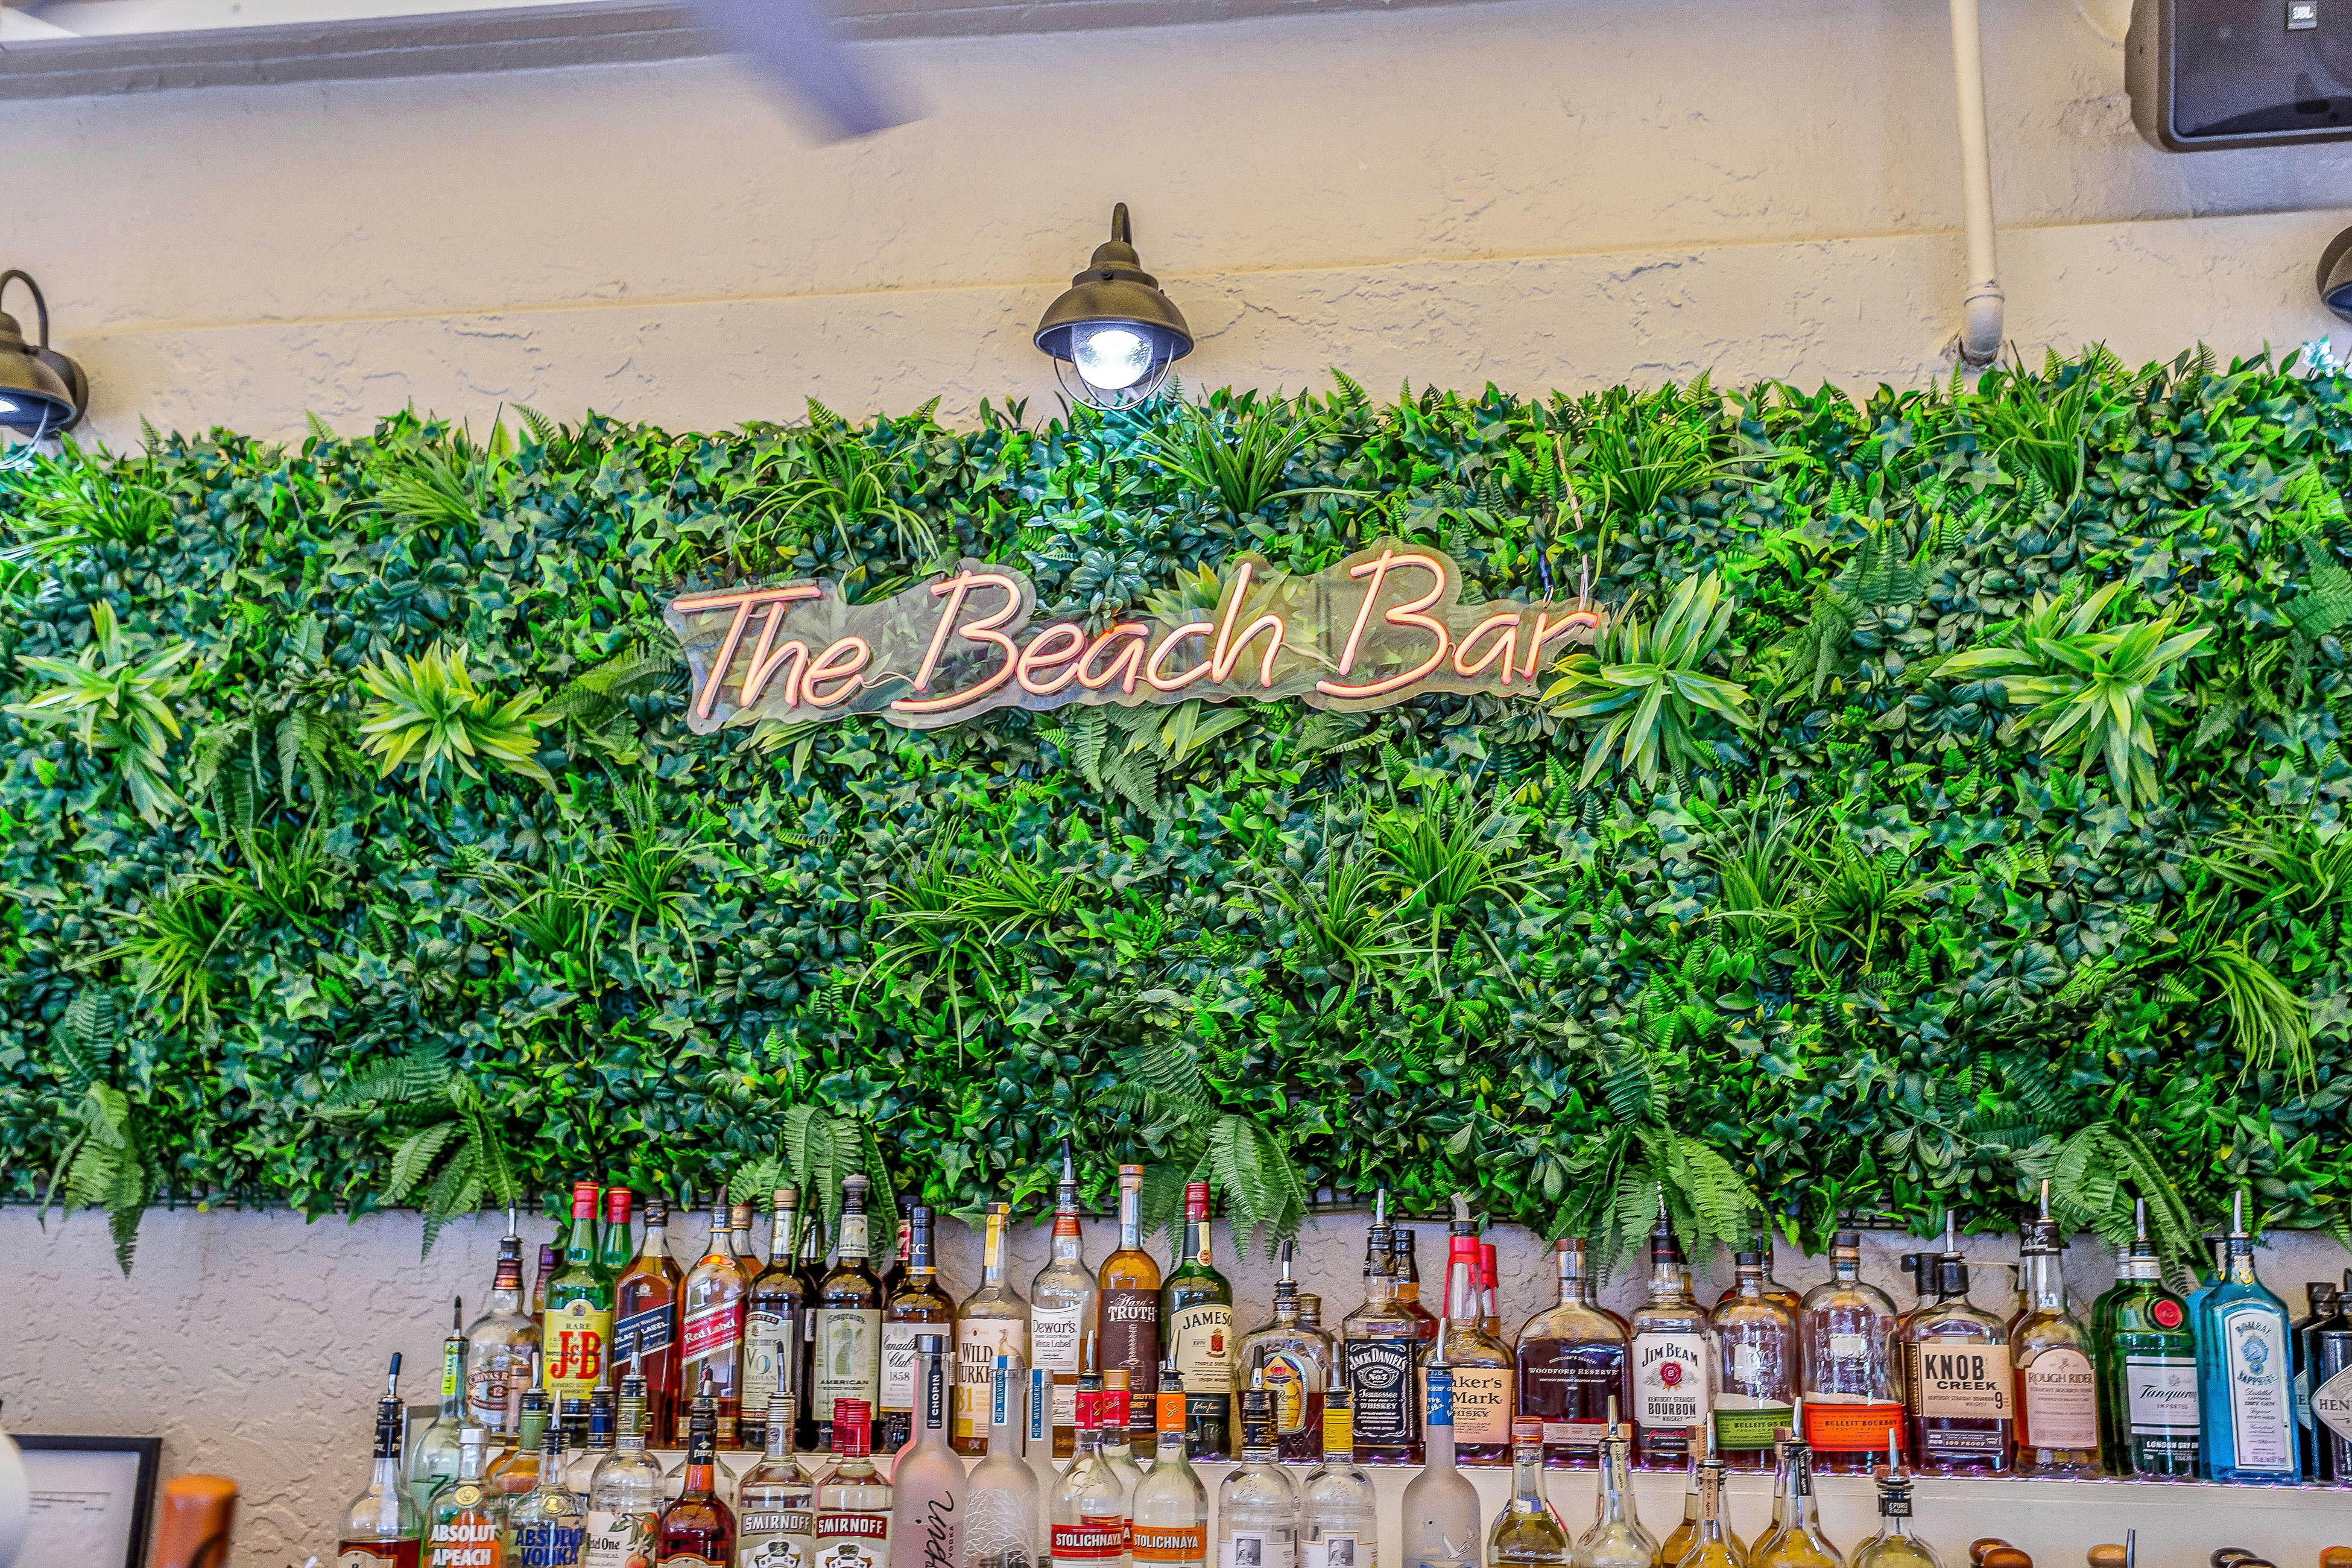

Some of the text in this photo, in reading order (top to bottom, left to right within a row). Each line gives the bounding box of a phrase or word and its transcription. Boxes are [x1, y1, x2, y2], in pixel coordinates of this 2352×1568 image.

[672, 548, 1599, 719] The Beach Bar
[1108, 1306, 1156, 1322] TRUTH
[1183, 1311, 1233, 1330] JAMESO
[614, 1332, 634, 1344] BLAC
[684, 1329, 707, 1344] Red
[706, 1317, 738, 1335] Label
[2235, 1321, 2272, 1338] BOMBAY
[549, 1330, 601, 1379] J&B
[962, 1342, 994, 1363] WILD
[1349, 1348, 1408, 1373] JACK DANIEL'S
[1642, 1342, 1698, 1367] JIM BEAM
[1924, 1354, 1984, 1380] KNOB
[889, 1371, 910, 1382] 1858
[1452, 1376, 1503, 1389] aker's
[1936, 1380, 1997, 1390] CREEK
[2028, 1372, 2066, 1385] ROUGH
[932, 1374, 940, 1416] CHOPIN
[958, 1386, 973, 1412] 81
[1358, 1389, 1399, 1399] Tennessee
[1452, 1391, 1503, 1405] Mark
[1994, 1391, 2003, 1409] 9
[1648, 1403, 1696, 1415] BOURBON
[745, 1515, 811, 1531] SMIRNOFF
[818, 1518, 884, 1534] SMIRNOFF
[431, 1524, 497, 1541] ABSOLUT
[1055, 1532, 1122, 1547] STOLICHNAYA
[601, 1537, 620, 1550] One
[1133, 1534, 1199, 1549] STOLICHNAYA
[432, 1548, 492, 1566] APEACH
[521, 1547, 578, 1566] VODKA
